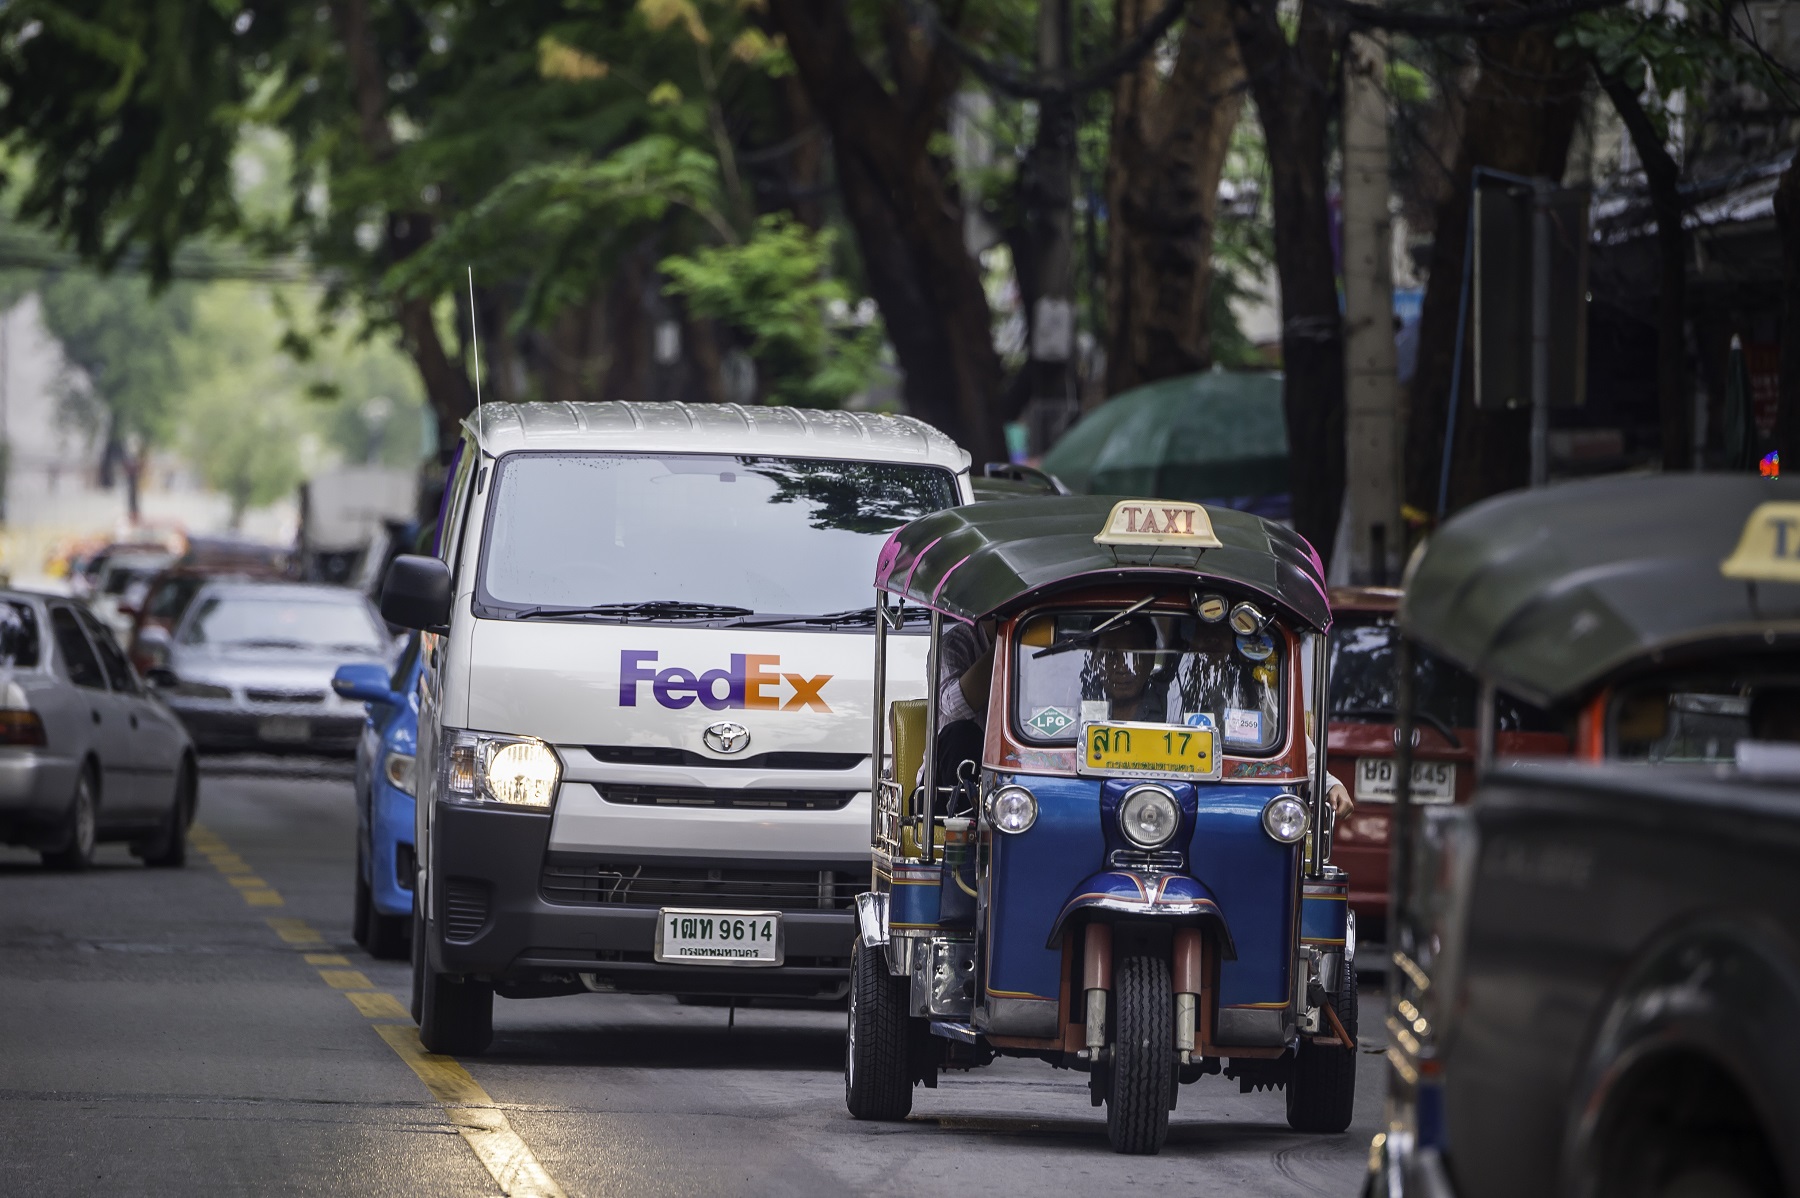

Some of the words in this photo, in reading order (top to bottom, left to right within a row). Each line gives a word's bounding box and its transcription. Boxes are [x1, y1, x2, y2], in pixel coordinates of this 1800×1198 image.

[1122, 507, 1196, 535] TAXI
[1766, 517, 1800, 560] T
[619, 650, 834, 713] FedEx
[1037, 716, 1065, 727] LPG
[1093, 728, 1131, 752] สก
[1163, 732, 1192, 756] 17
[1120, 770, 1179, 778] TOYOTA
[719, 919, 772, 941] 9614
